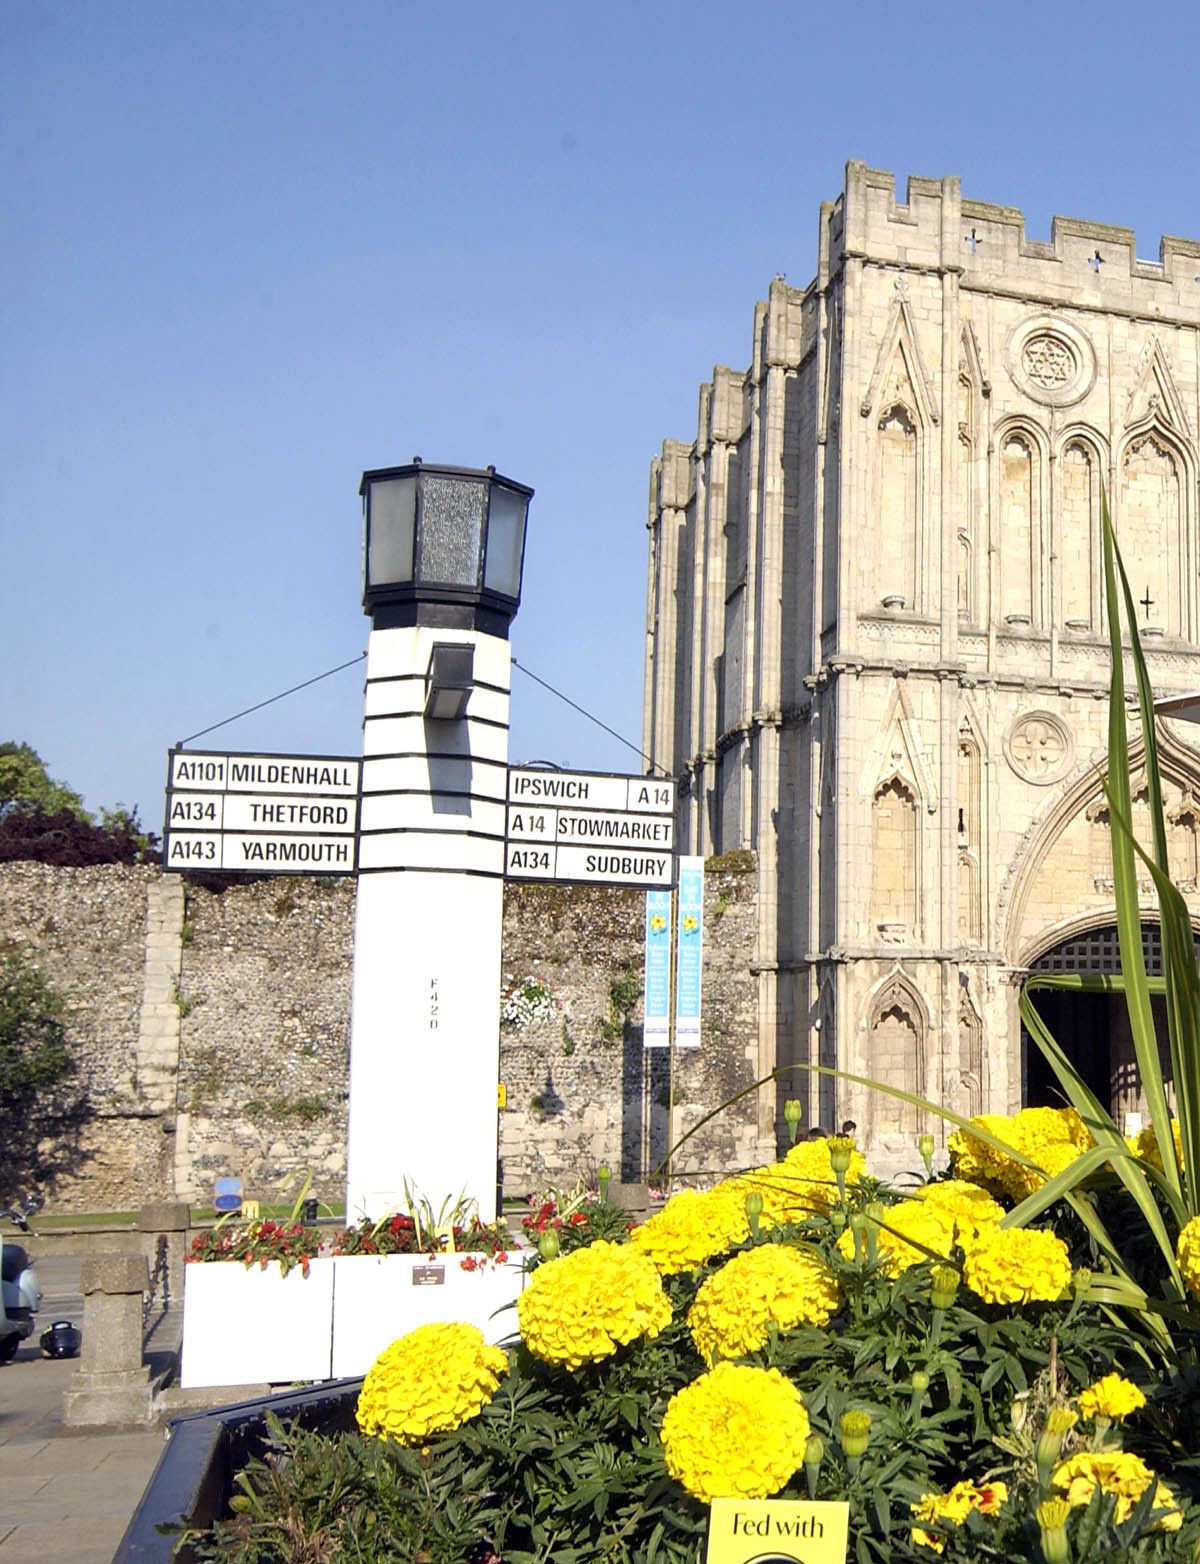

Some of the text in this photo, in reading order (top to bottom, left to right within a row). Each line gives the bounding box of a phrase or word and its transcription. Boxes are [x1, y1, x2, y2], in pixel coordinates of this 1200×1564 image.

[176, 761, 352, 786] A1101 MILDENHALL
[514, 777, 589, 799] IPSWICH
[171, 801, 348, 825] A134 THETFORD
[558, 817, 671, 841] STOWMARKET
[171, 840, 348, 862] A143 YARMOUTH
[510, 850, 667, 877] A134 SUDBURY
[733, 1512, 824, 1539] Fed with
